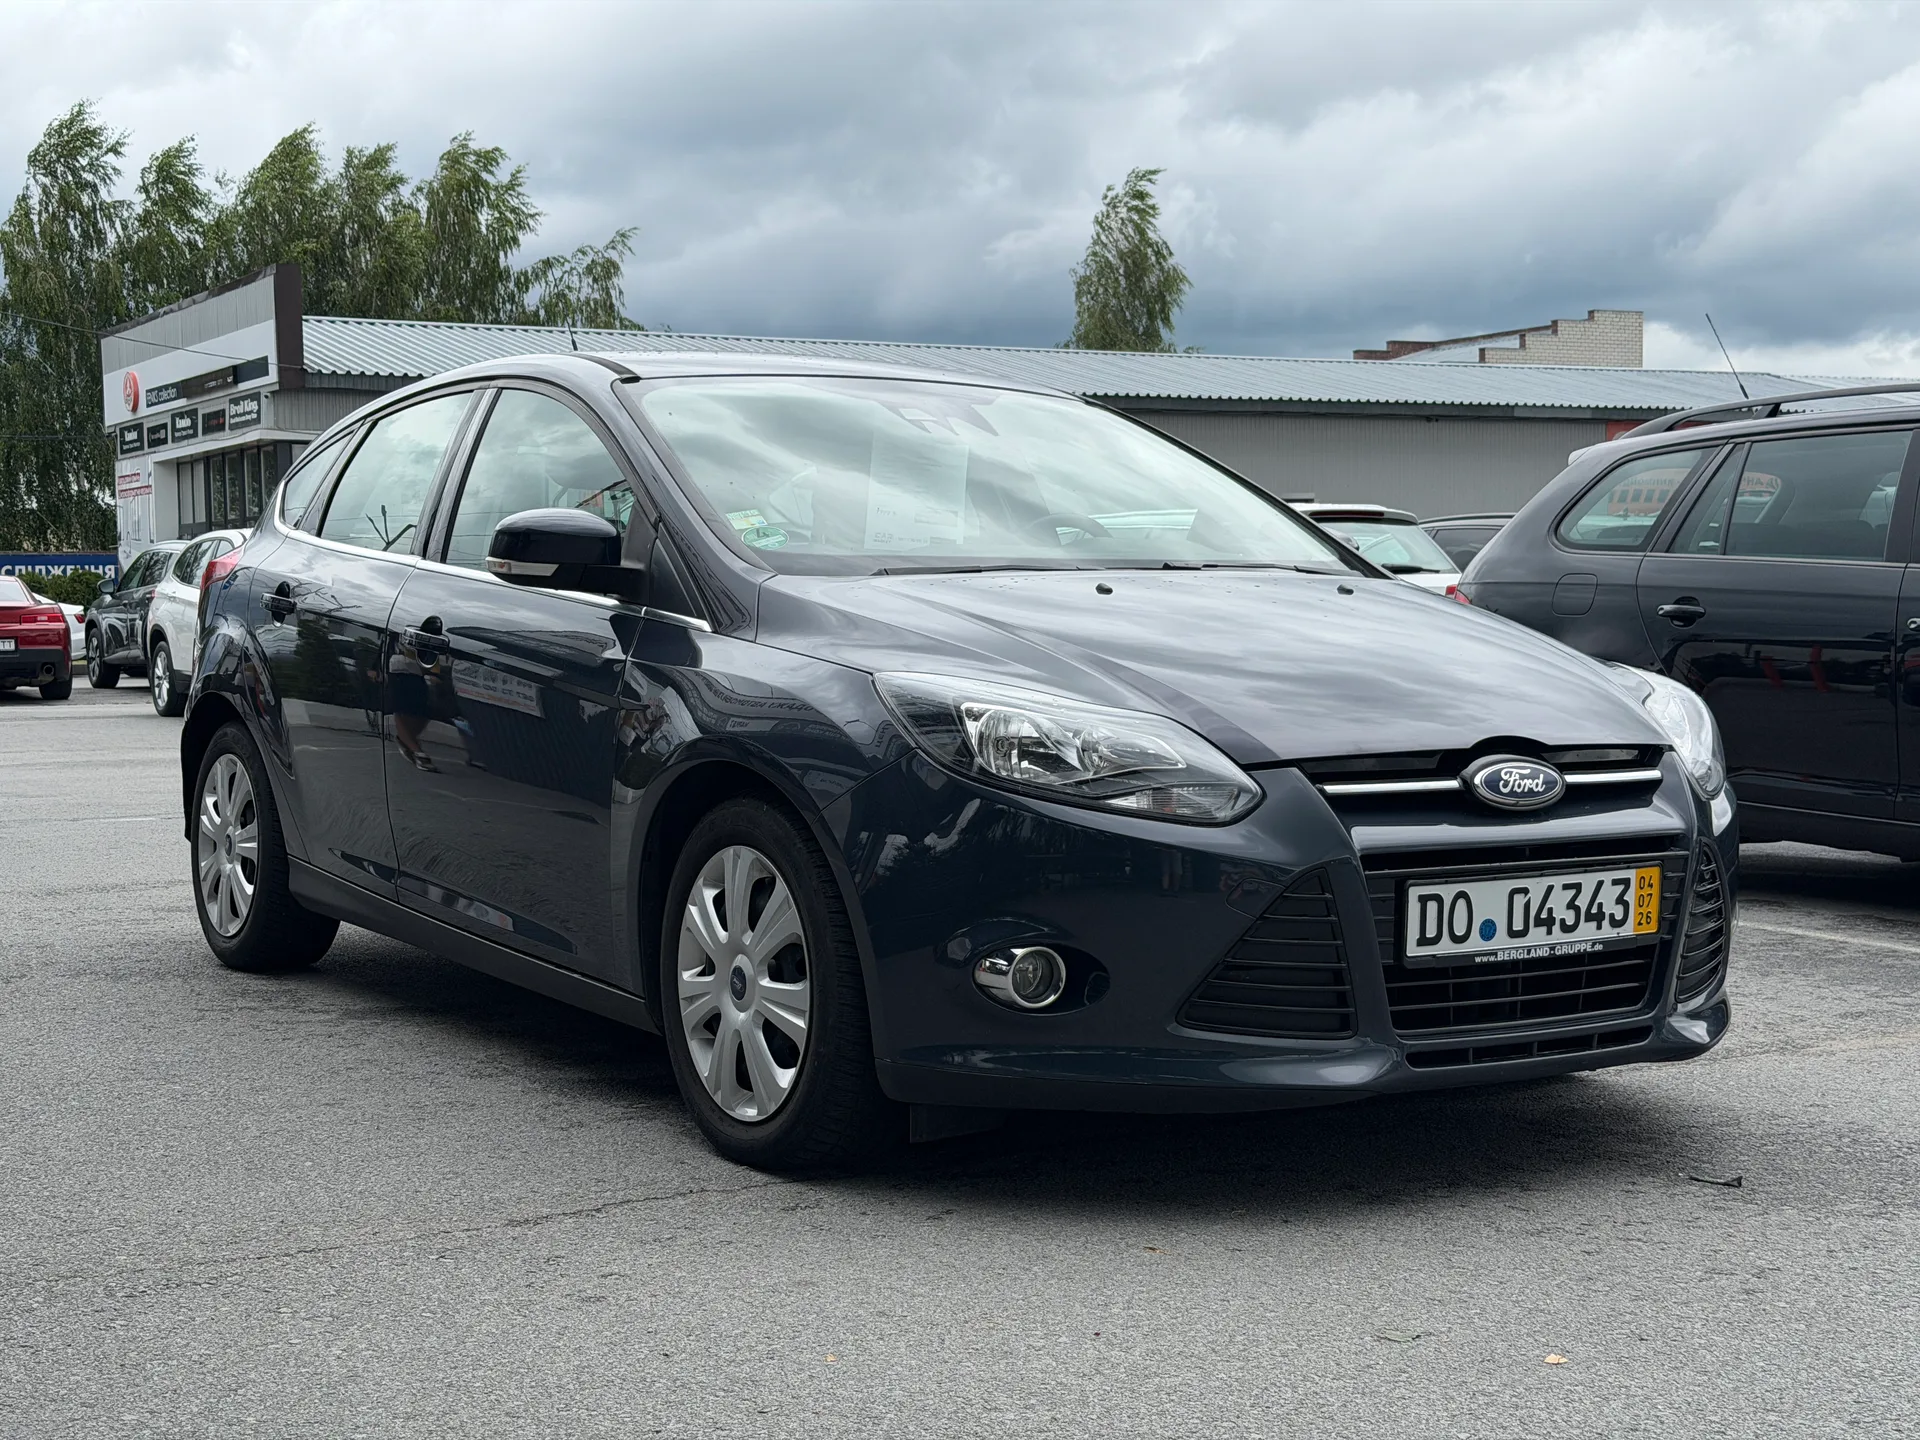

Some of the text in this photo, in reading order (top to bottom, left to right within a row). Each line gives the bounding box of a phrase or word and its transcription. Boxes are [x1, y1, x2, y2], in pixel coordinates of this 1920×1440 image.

[229, 400, 244, 416] Broil
[1499, 768, 1546, 793] Ford
[1639, 875, 1654, 890] 04
[1638, 892, 1654, 908] 07
[1416, 876, 1632, 947] DO 04343
[1637, 910, 1652, 926] 26
